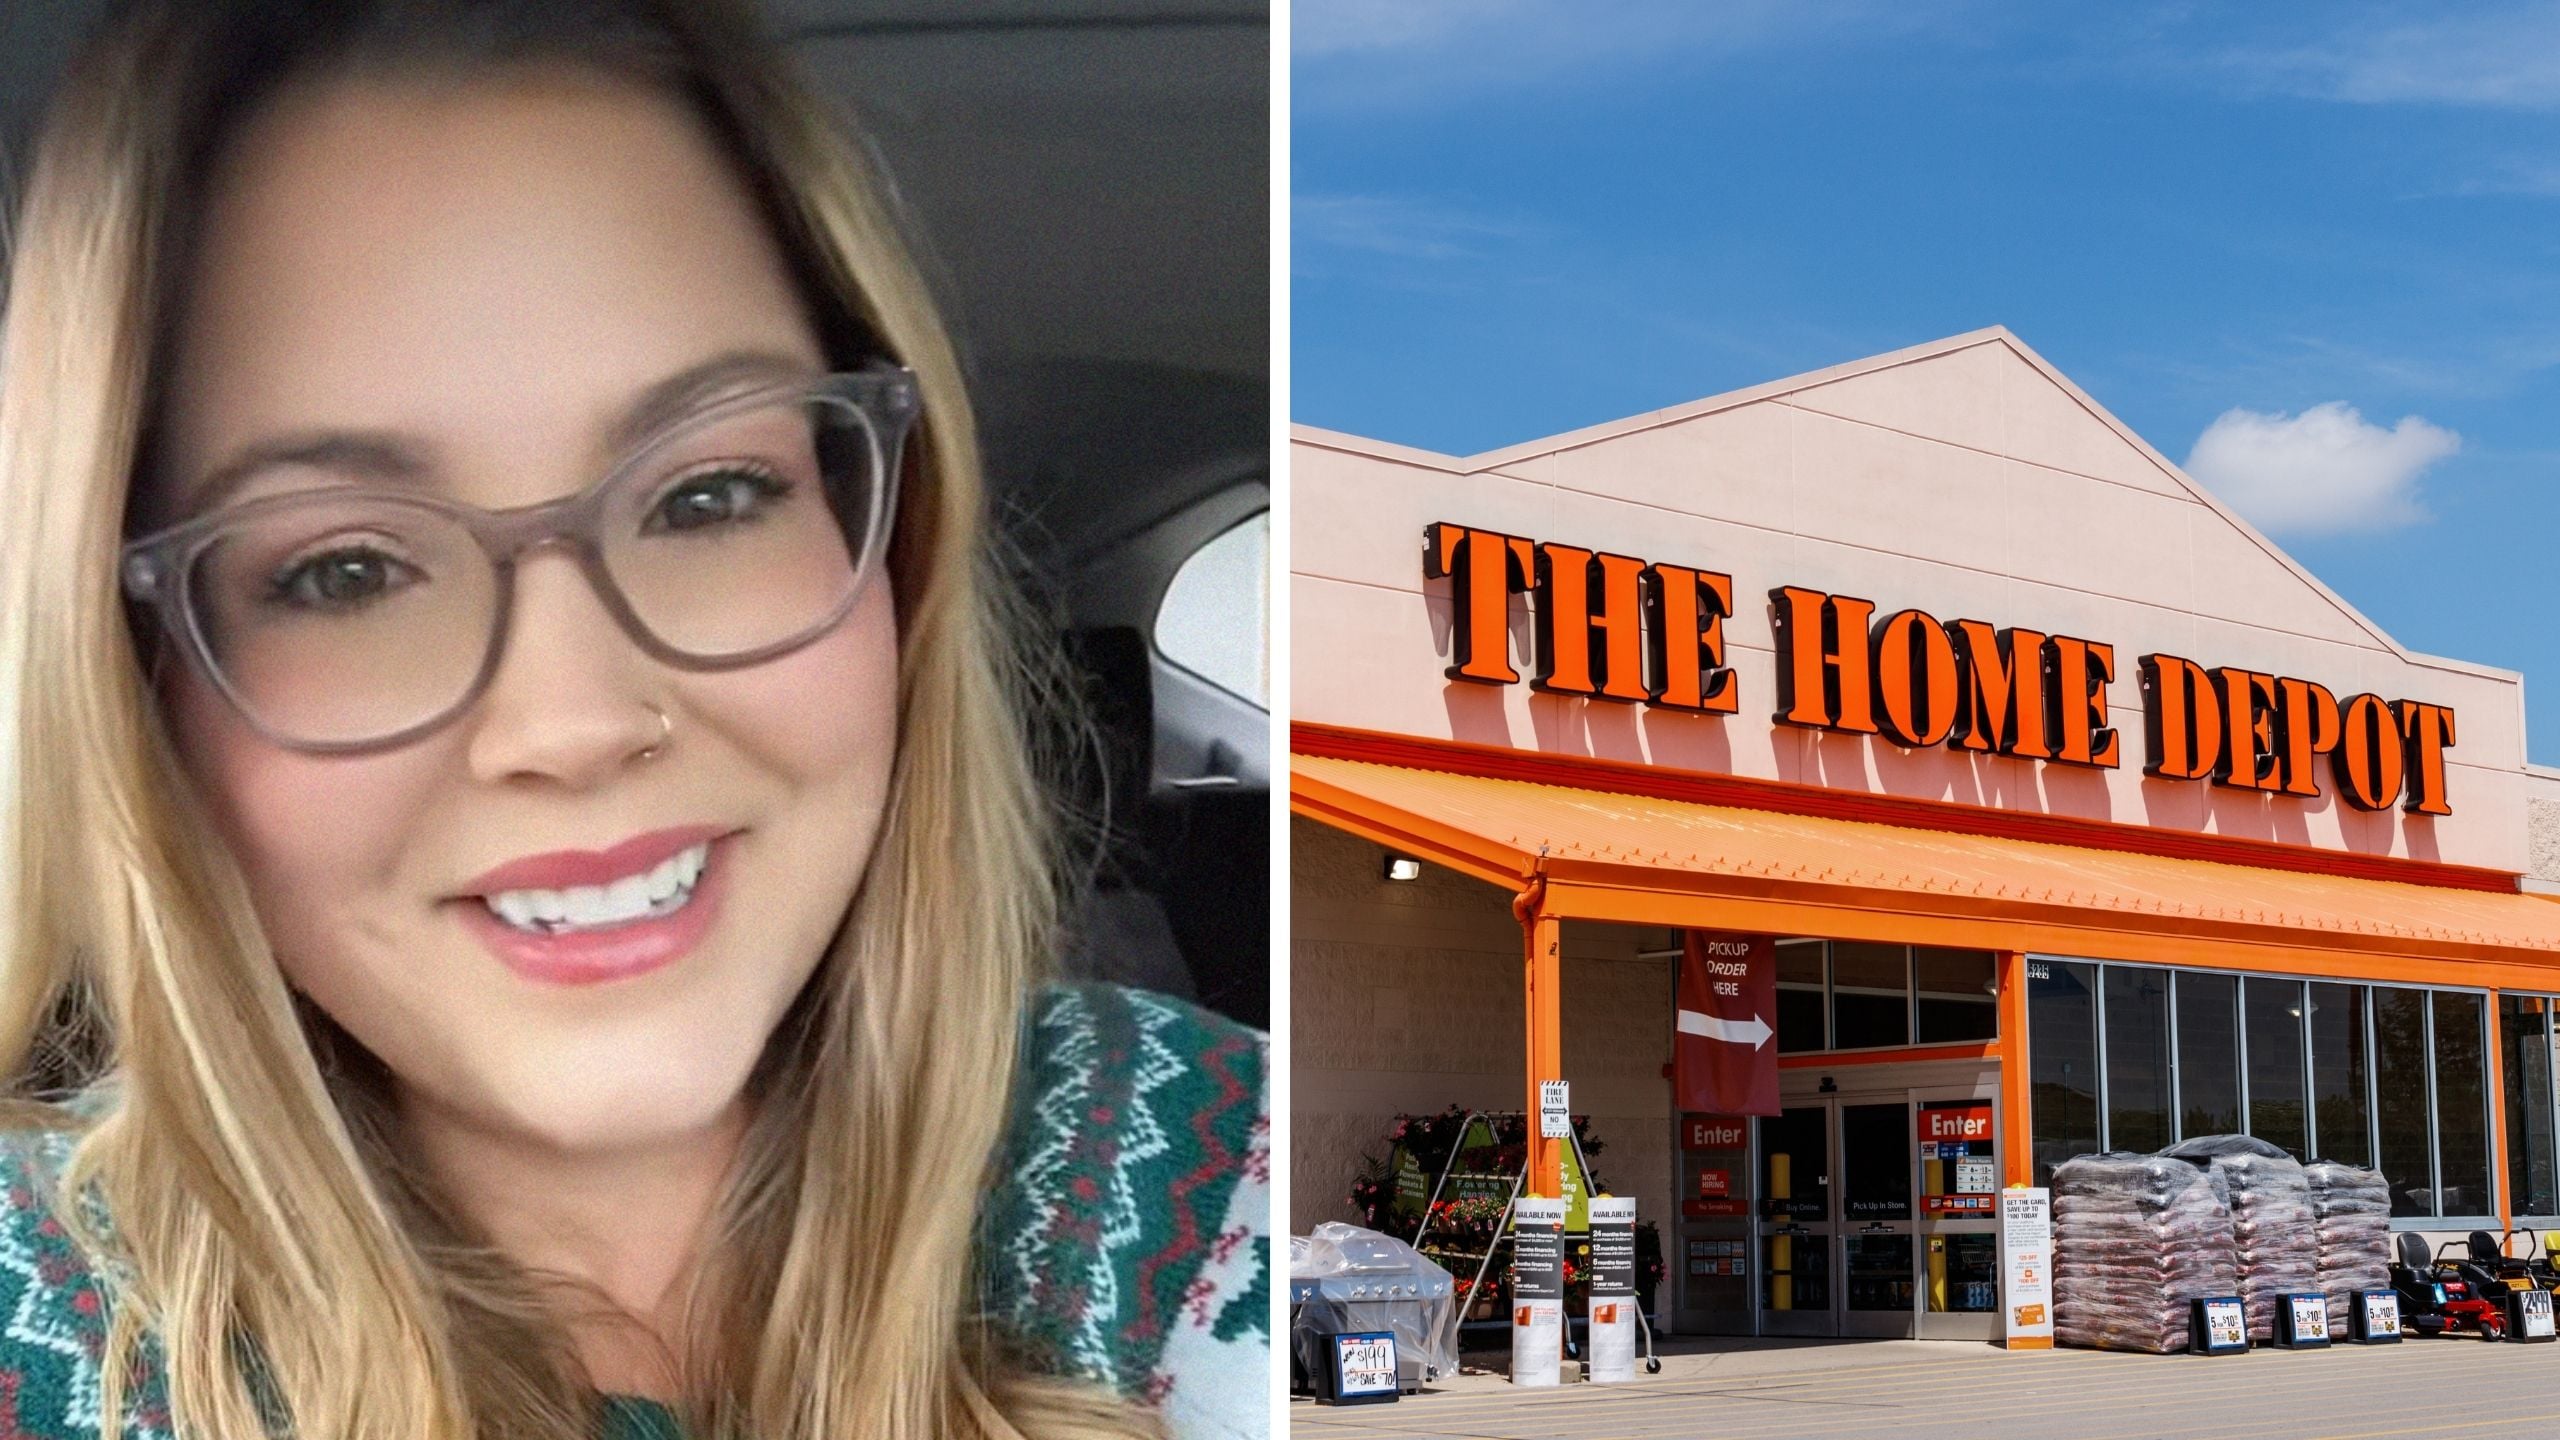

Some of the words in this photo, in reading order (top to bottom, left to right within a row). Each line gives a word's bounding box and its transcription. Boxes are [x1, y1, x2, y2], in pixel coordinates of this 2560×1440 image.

[1422, 521, 1739, 715] THE
[1768, 585, 2120, 770] HOME
[2138, 653, 2455, 817] DEPOT
[1708, 942, 1749, 956] PICKUP
[1707, 960, 1747, 976] ORDER
[1713, 981, 1739, 996] HERE
[1545, 1096, 1564, 1104] LANE
[1931, 1114, 1986, 1136] Enter
[1694, 1124, 1742, 1145] Enter
[1702, 1173, 1718, 1181] NOW
[1702, 1181, 1725, 1189] HIRING
[1854, 1201, 1867, 1210] Pick
[1869, 1202, 1878, 1212] Up
[1888, 1200, 1907, 1210] Store.
[1546, 1211, 1562, 1219] NOW
[1592, 1210, 1626, 1218] AVAILABLE
[2296, 1311, 2302, 1323] 5
[2369, 1307, 2375, 1320] 5
[2211, 1316, 2217, 1328] 5
